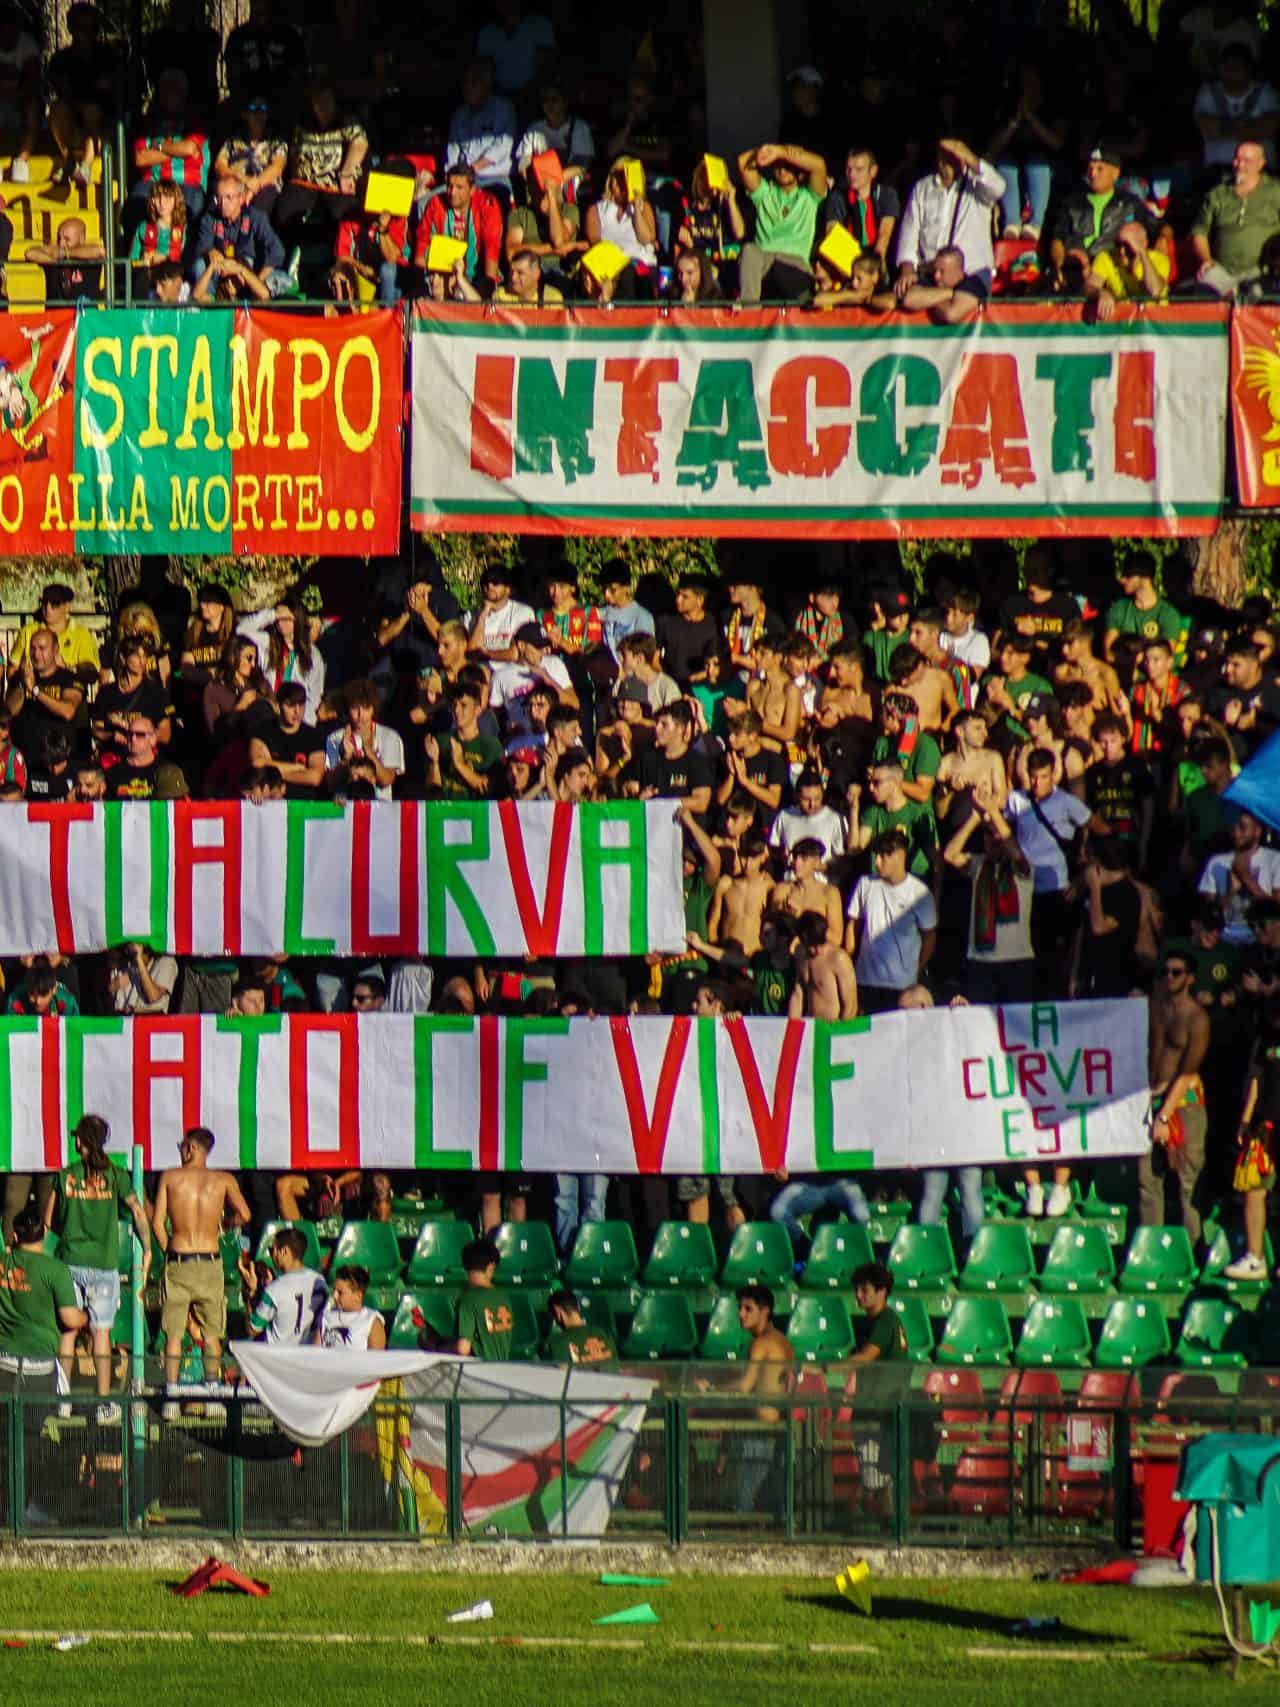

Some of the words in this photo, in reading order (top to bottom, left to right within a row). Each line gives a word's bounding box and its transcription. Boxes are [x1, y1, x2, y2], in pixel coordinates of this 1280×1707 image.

[80, 335, 381, 453] STAMPO
[470, 352, 1156, 491] INTACCATI
[40, 473, 154, 532] ALLA
[169, 474, 376, 533] MORTE...
[28, 801, 241, 957] TUA
[284, 801, 648, 957] CURVA
[997, 1002, 1058, 1052] LA
[610, 1015, 874, 1175] VIVE
[962, 1048, 1113, 1100] CURVA
[1001, 1102, 1100, 1160] EST
